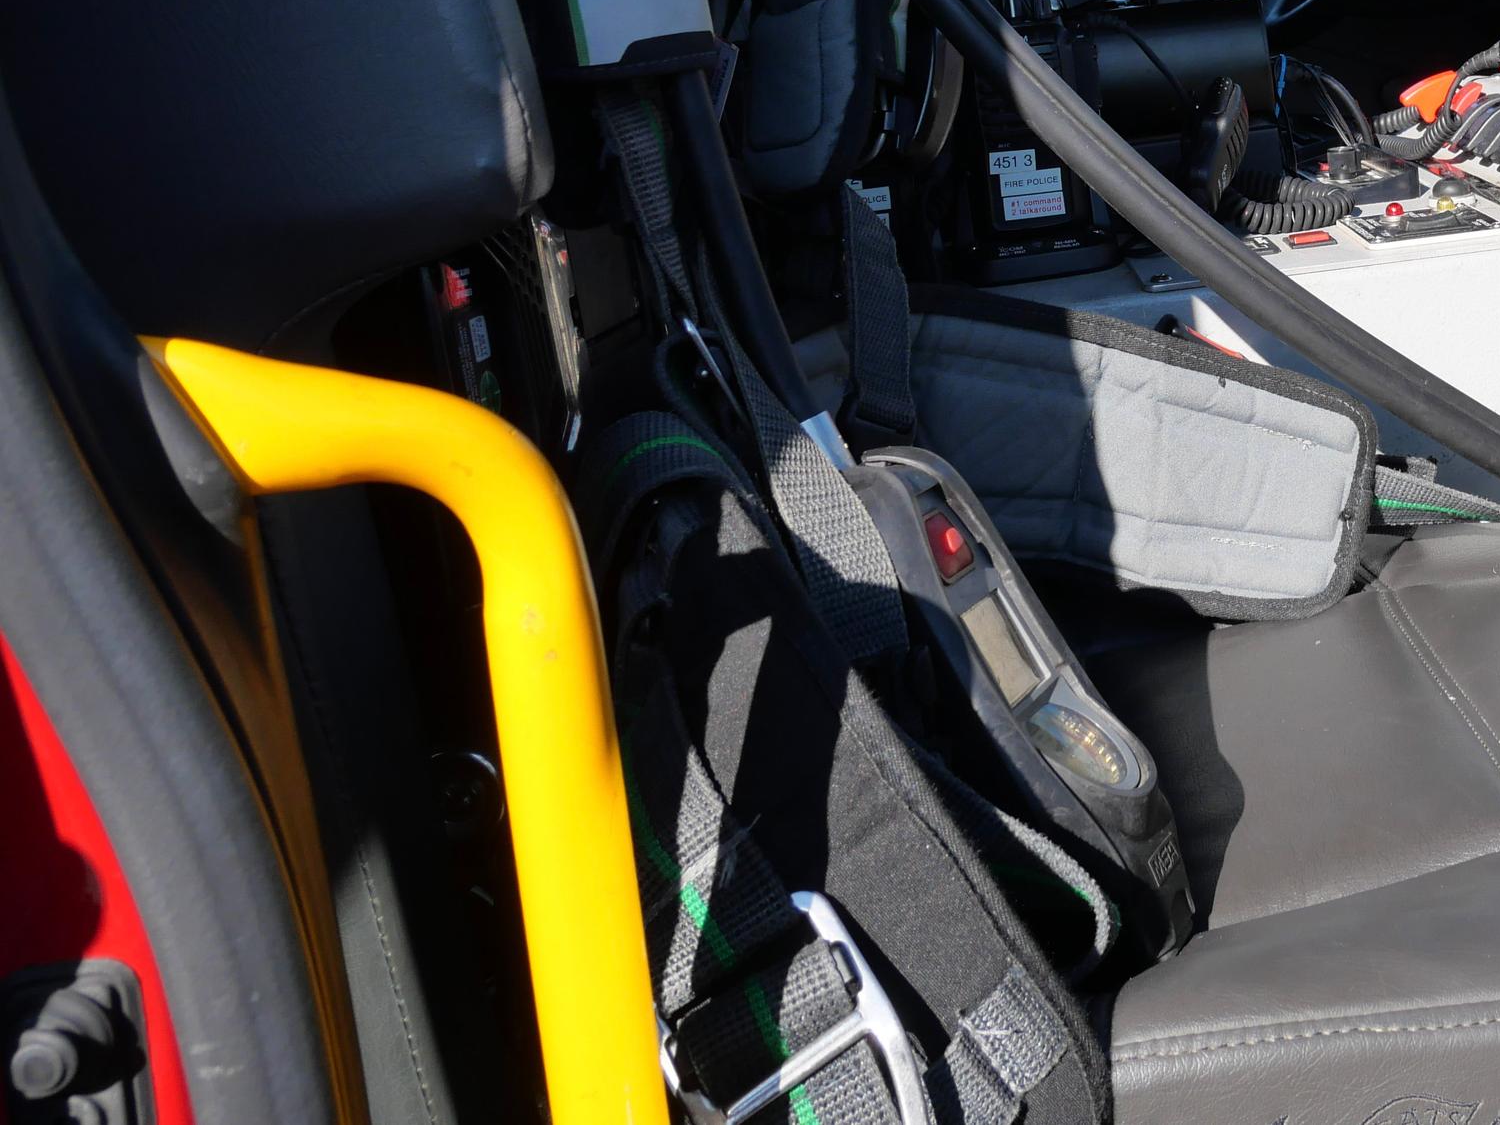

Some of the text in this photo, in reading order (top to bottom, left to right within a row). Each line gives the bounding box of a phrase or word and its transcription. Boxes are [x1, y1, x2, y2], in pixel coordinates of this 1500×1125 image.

[993, 154, 1033, 169] 451 3
[1004, 176, 1058, 188] FIRE POLICE
[1011, 196, 1062, 208] #1 command
